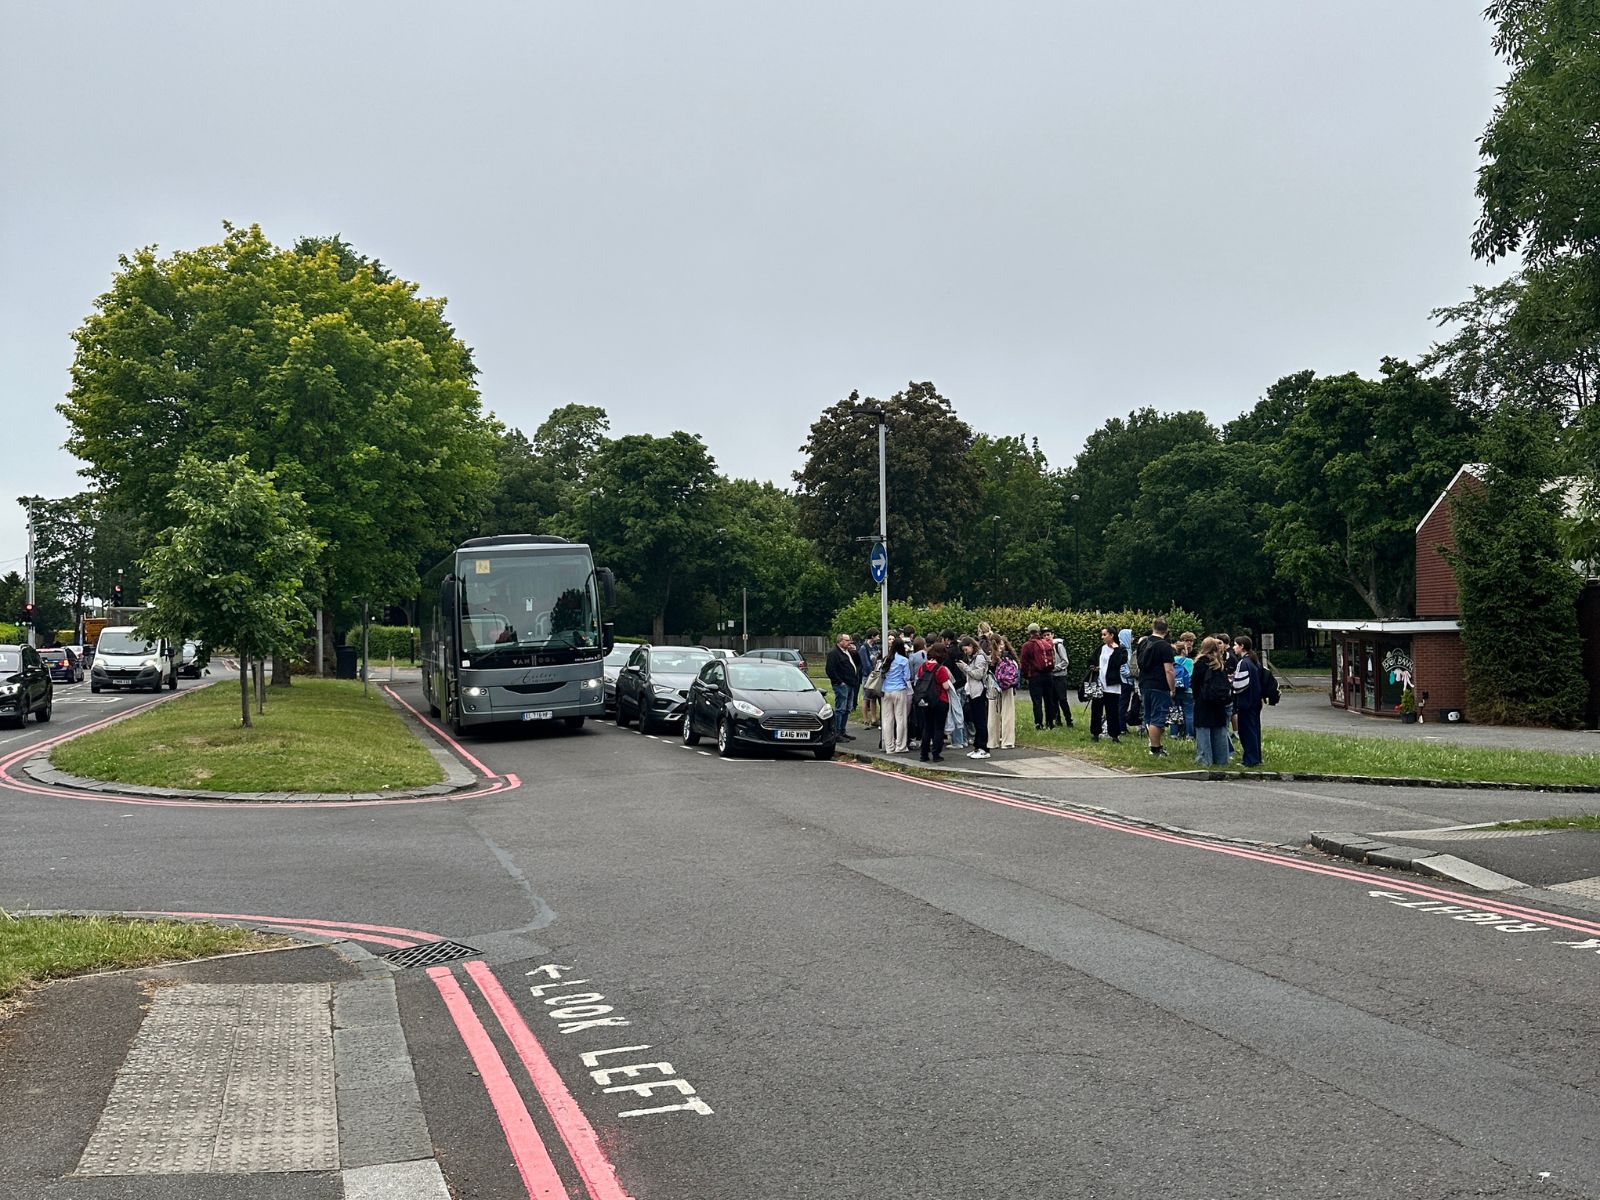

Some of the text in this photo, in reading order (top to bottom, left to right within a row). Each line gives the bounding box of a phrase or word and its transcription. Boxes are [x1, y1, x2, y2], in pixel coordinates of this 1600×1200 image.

[1389, 901, 1551, 933] RIGHT
[529, 978, 715, 1118] LOOK LEFT
